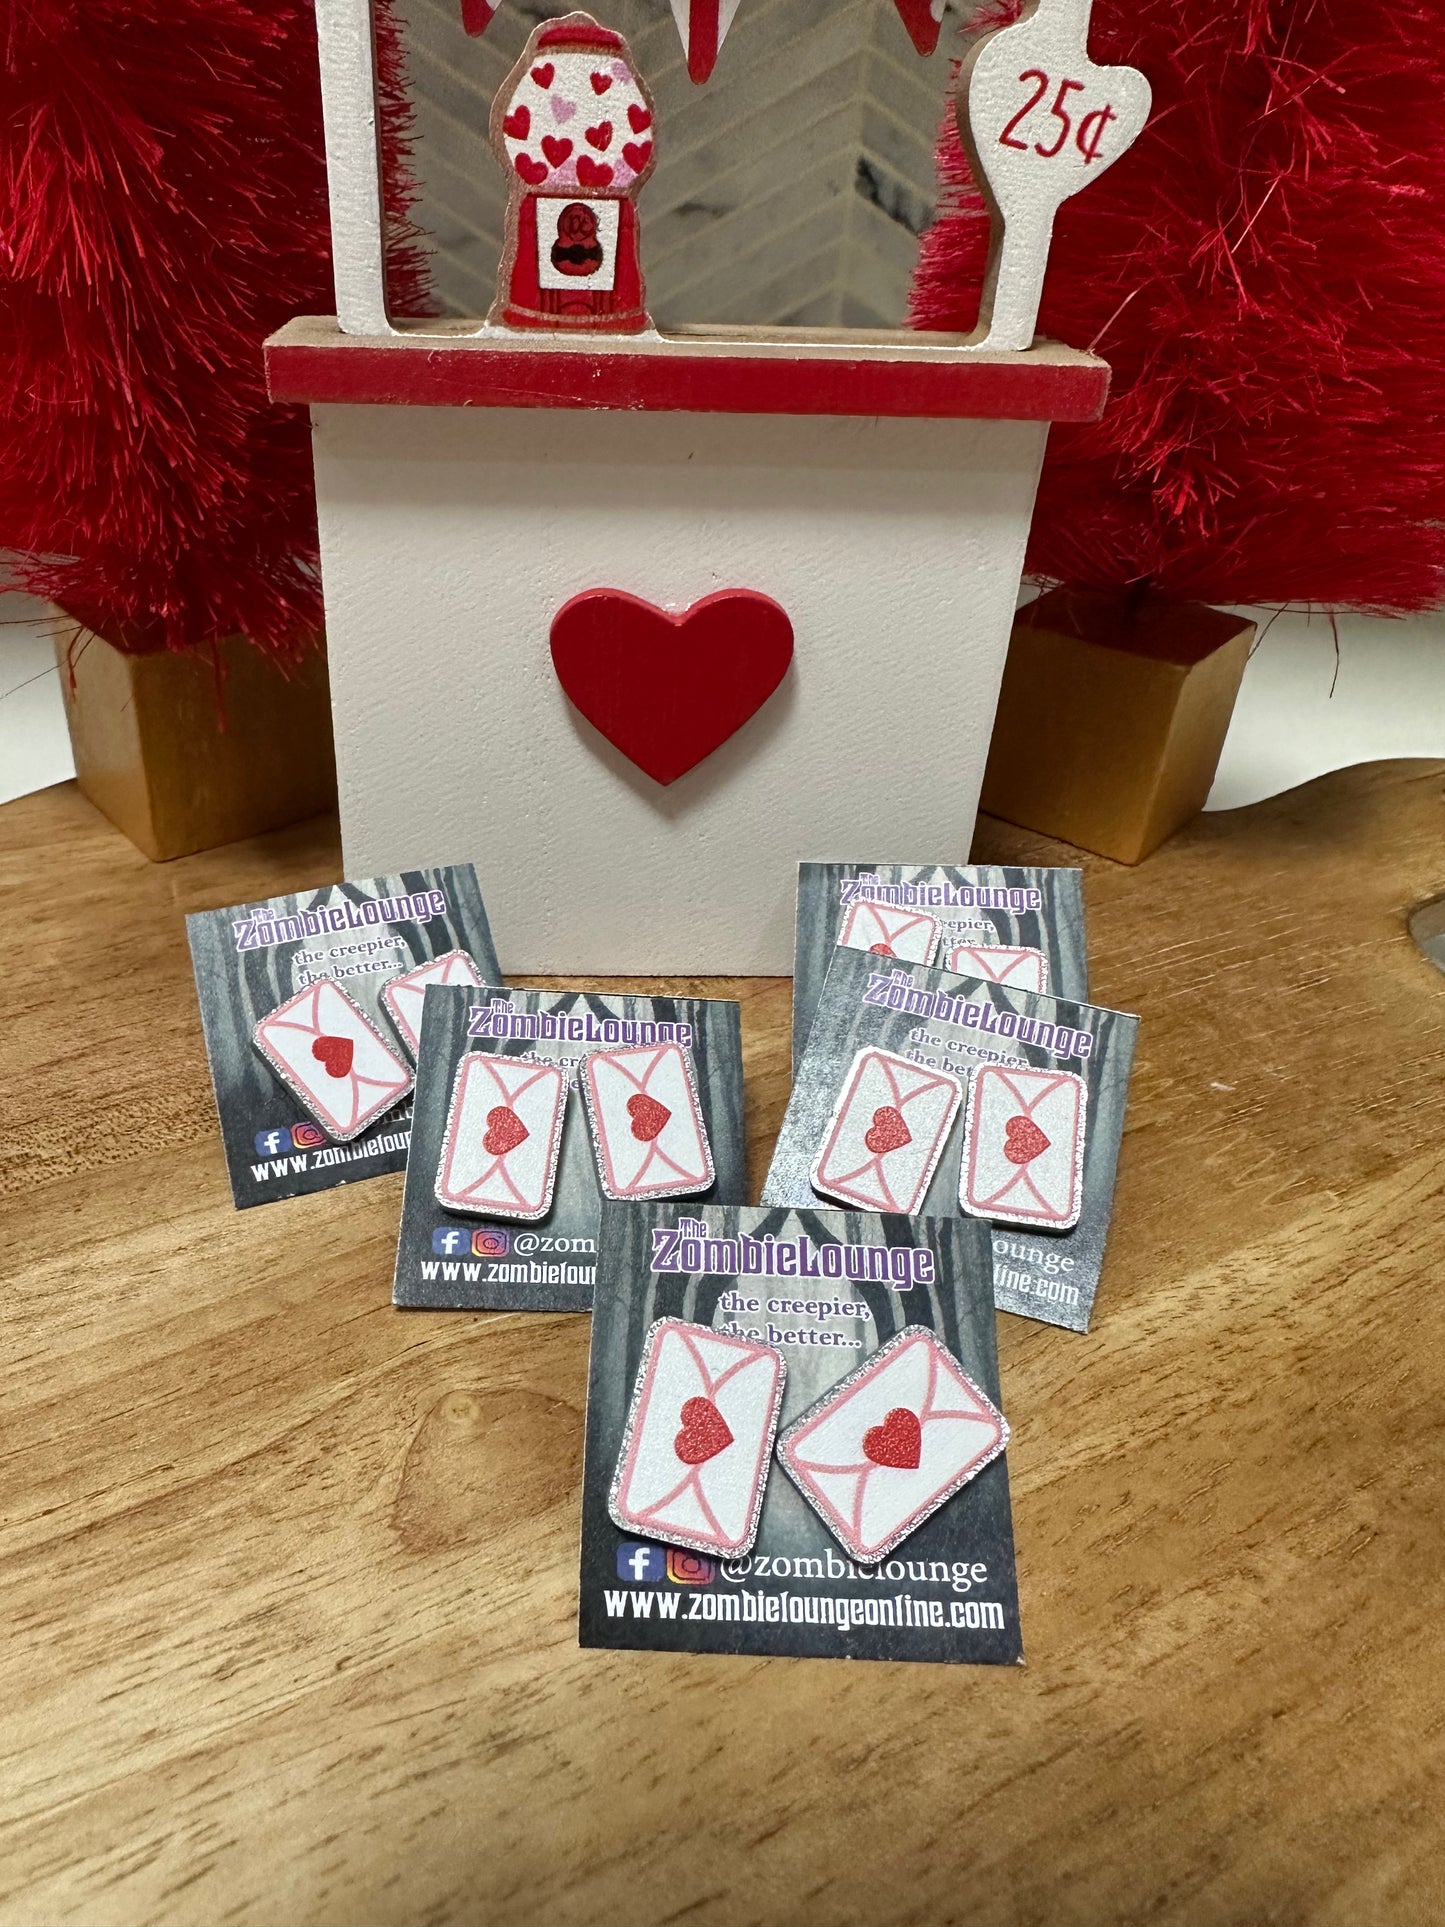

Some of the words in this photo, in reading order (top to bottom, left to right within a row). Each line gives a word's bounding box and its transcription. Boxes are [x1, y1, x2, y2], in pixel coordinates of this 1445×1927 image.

[999, 69, 1117, 165] 25¢
[859, 872, 879, 885] The
[252, 908, 274, 923] The
[294, 951, 324, 966] the
[330, 936, 406, 959] creepier,
[335, 960, 403, 978] better...
[892, 970, 914, 987] The
[492, 999, 514, 1013] The
[910, 1028, 942, 1047] the
[905, 1051, 937, 1068] the
[679, 1217, 707, 1238] The
[651, 1229, 935, 1290] ZombieLounge
[719, 1292, 760, 1312] the
[767, 1296, 871, 1320] creepier,
[767, 1323, 862, 1348] better...
[603, 1589, 1005, 1631] www.zombieloungeonline.com
